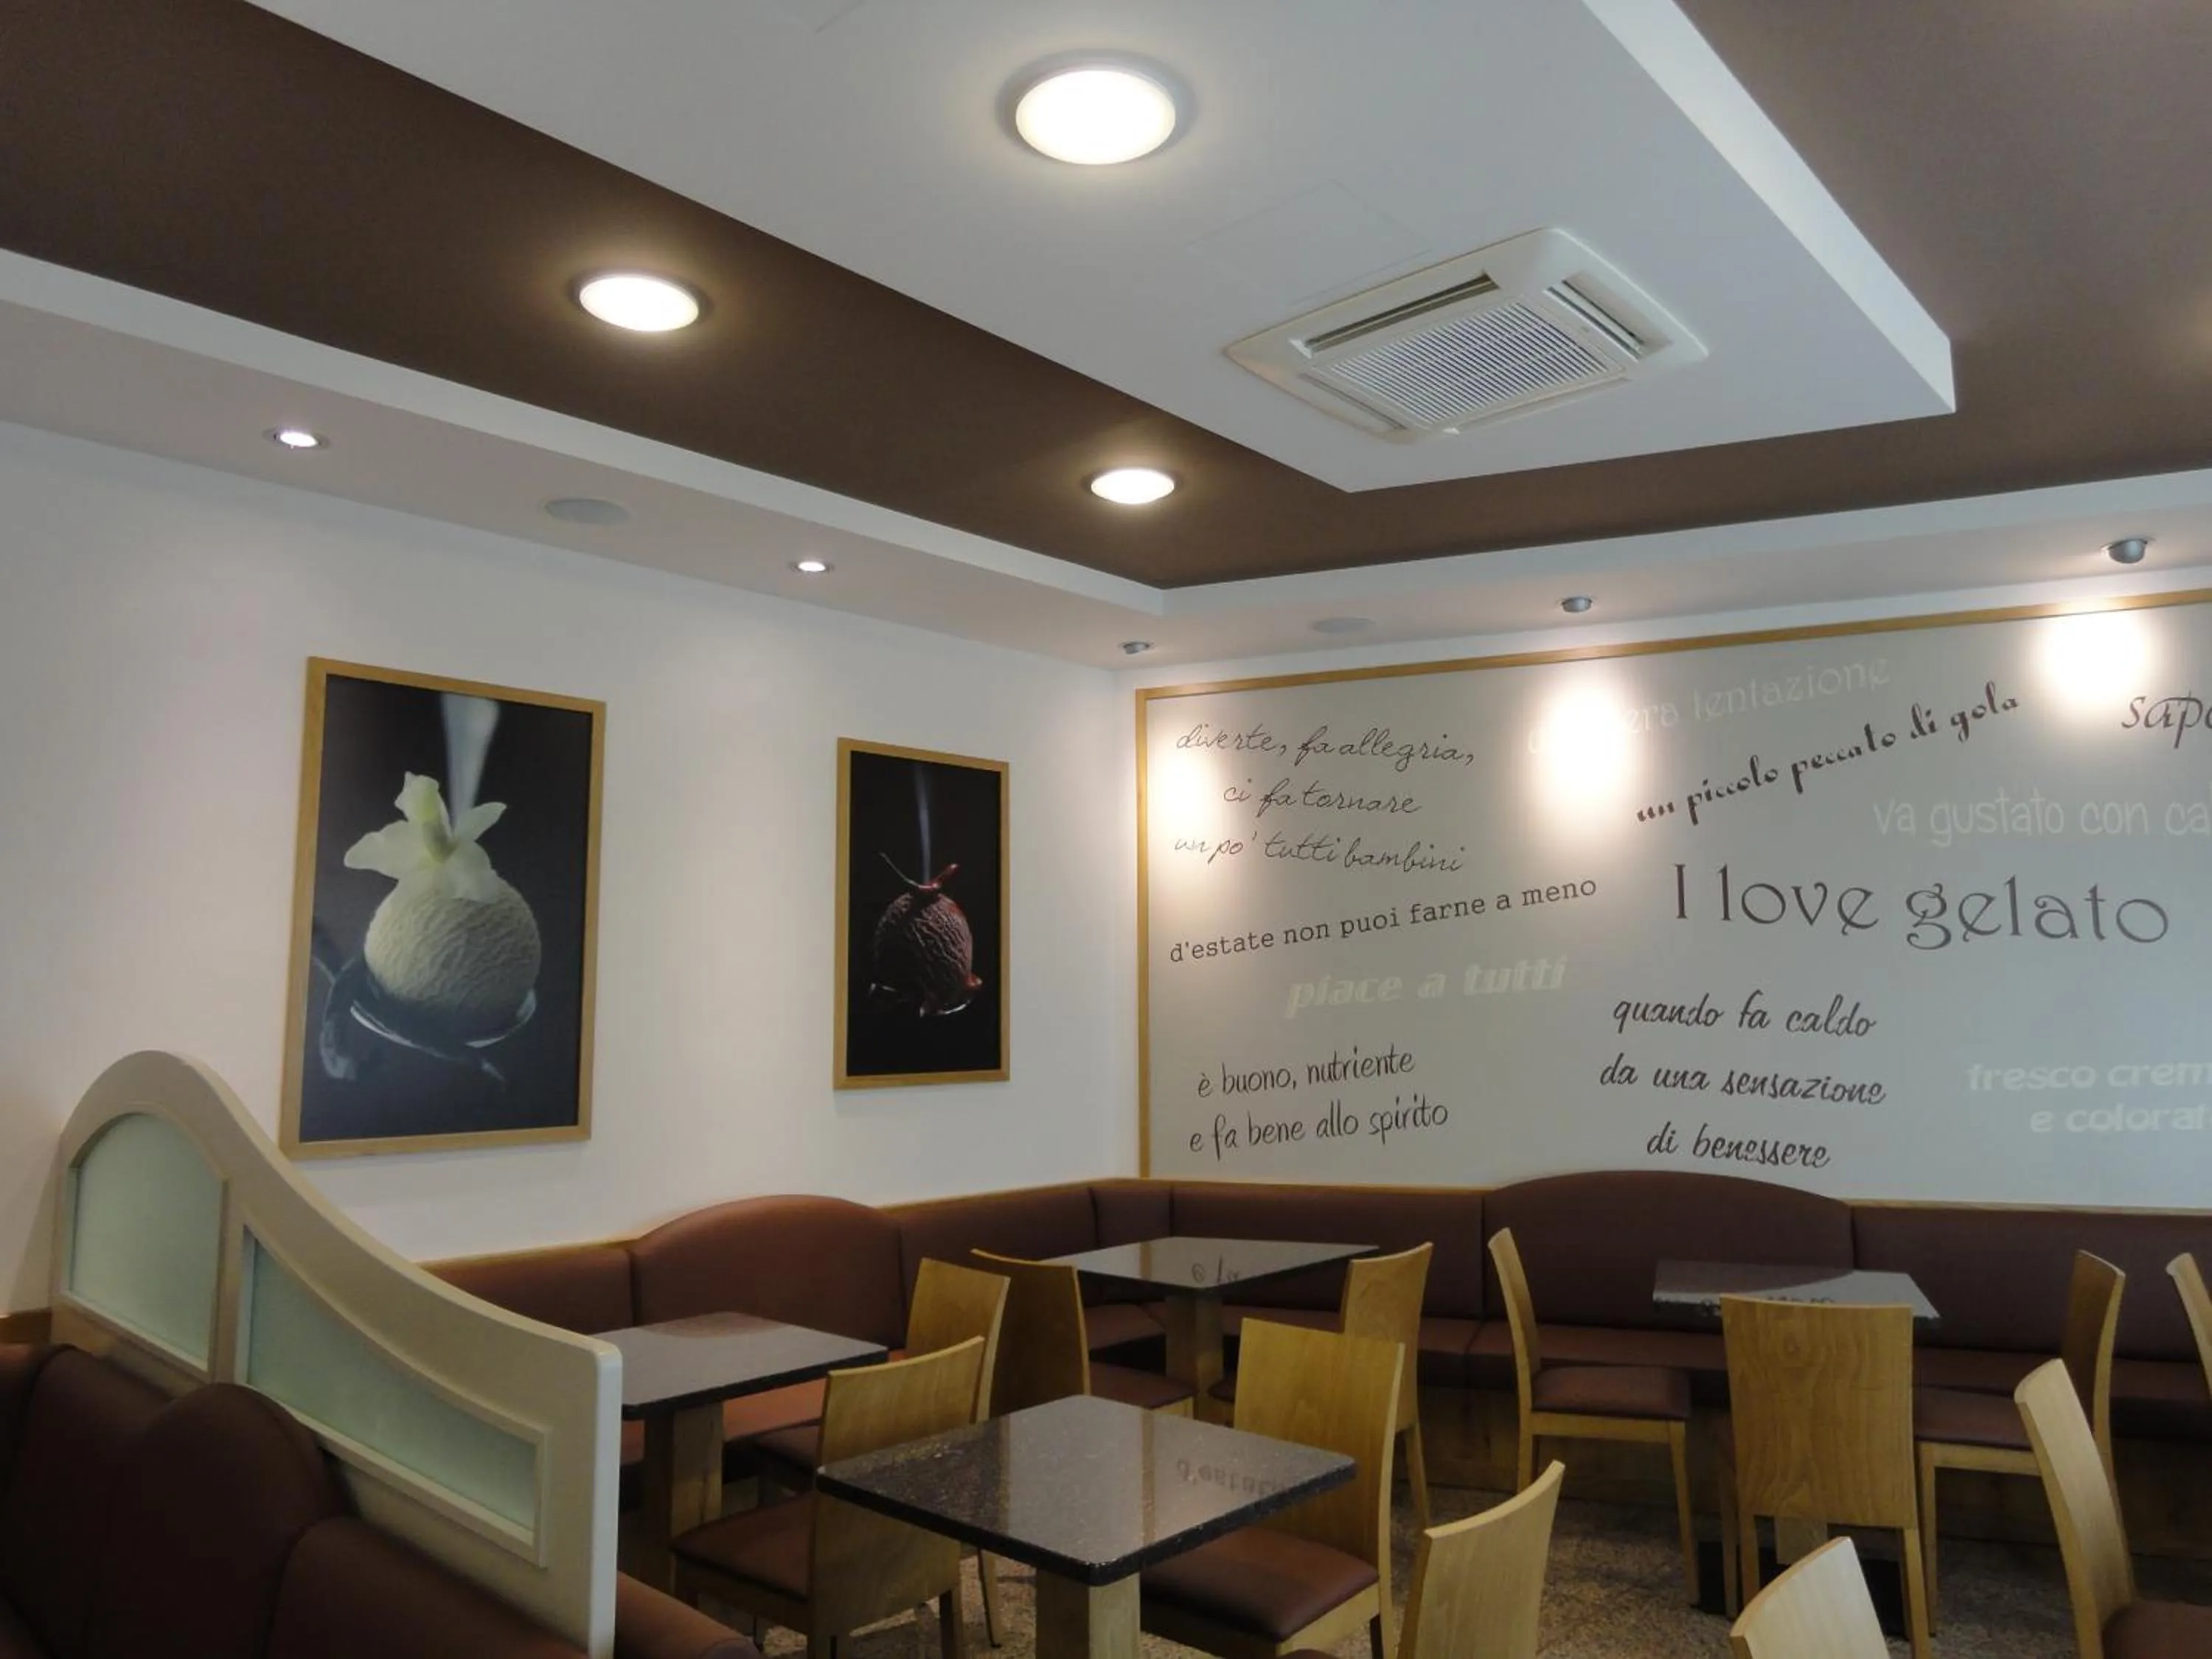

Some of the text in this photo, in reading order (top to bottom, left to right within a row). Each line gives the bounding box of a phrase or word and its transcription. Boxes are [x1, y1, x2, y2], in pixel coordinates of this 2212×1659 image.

[1613, 697, 1680, 734] era
[1176, 723, 1474, 771] diverte, fa allegria,
[1636, 679, 2020, 826] un piccolo peccato di gola
[1223, 779, 1422, 818] ci fa tornare
[1873, 796, 1916, 835] va
[1930, 785, 2064, 848] gustato
[2079, 800, 2149, 837] con
[1175, 831, 1466, 872] un po' tutti bambini
[1170, 880, 1596, 962] d'estate non puoi farne a meno
[1673, 863, 2169, 951] I love gelato
[1284, 955, 1568, 1020] piace a tutti
[1613, 989, 1877, 1037] quando fa caldo
[1197, 1043, 1415, 1098] è buono, nutriente
[1599, 1052, 1887, 1106] da una sensazione
[1967, 1064, 2096, 1091] fresco
[1189, 1093, 1449, 1161] e fa bene allo spirito
[1646, 1121, 1831, 1169] di benessere
[2030, 1110, 2055, 1133] e
